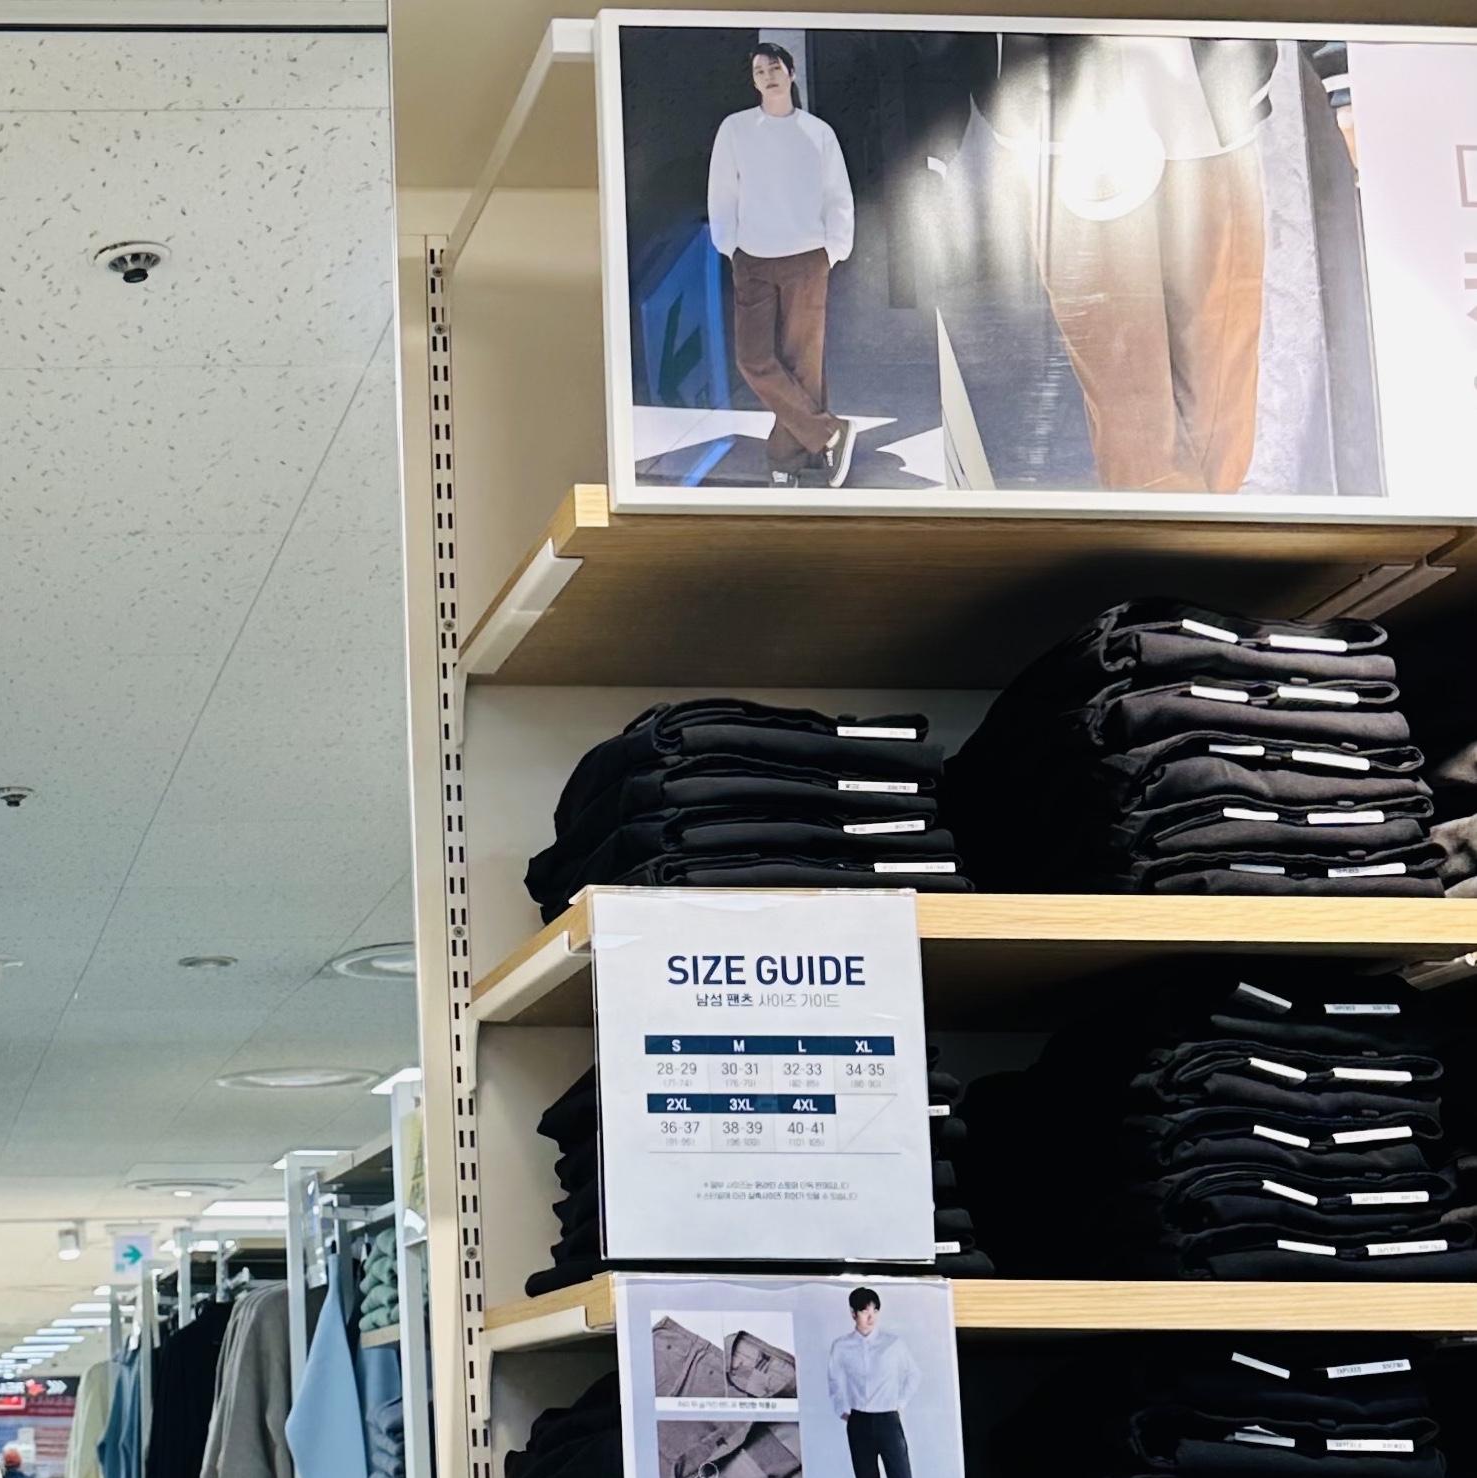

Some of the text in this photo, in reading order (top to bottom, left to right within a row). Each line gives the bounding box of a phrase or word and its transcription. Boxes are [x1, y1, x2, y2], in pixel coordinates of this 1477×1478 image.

[667, 956, 866, 986] SIZE GUIDE
[696, 993, 841, 1008] 남성 팬츠 사이즈 가이드
[672, 1040, 873, 1053] S M L XL
[657, 1062, 885, 1077] 28-29 30-31 32-33 34-35
[666, 1098, 818, 1112] 2XL 3XL 4XL
[660, 1121, 825, 1135] 36-37 38-39 40-41
